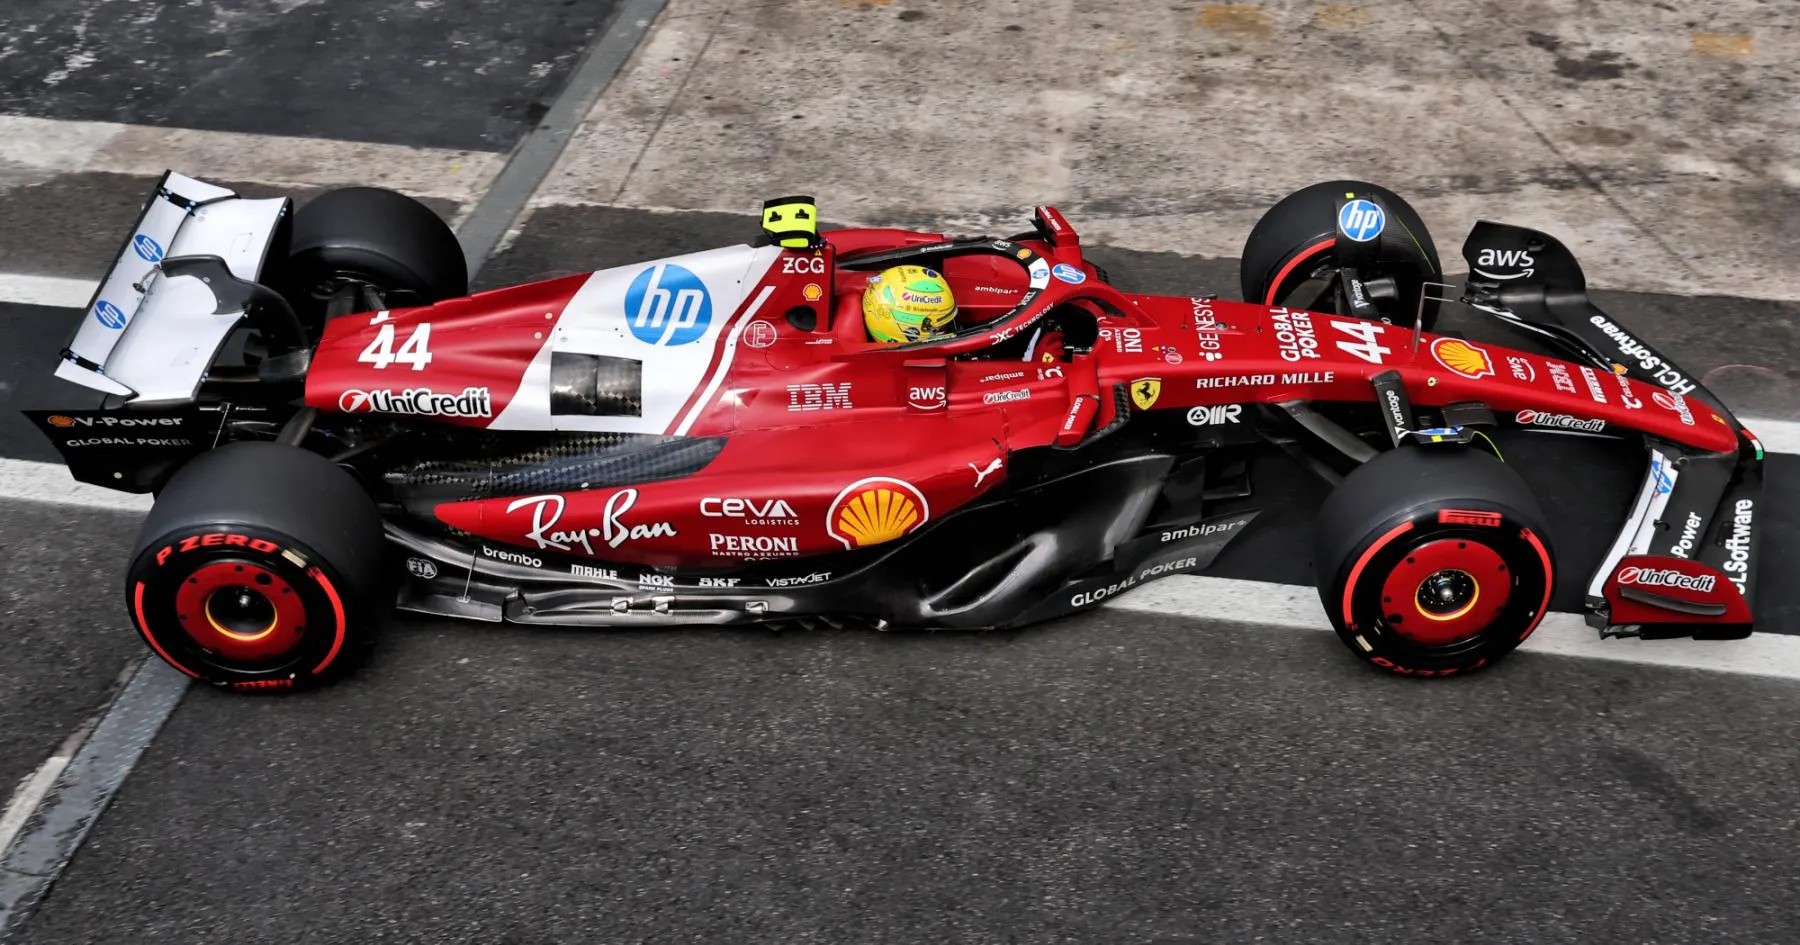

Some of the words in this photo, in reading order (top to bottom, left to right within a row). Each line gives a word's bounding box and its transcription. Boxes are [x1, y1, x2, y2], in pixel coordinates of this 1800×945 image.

[1344, 200, 1379, 241] hp
[134, 234, 163, 262] hp
[1477, 248, 1534, 267] aws
[911, 295, 943, 304] UniCredit
[975, 286, 1013, 294] ambipar
[95, 301, 126, 329] hp
[633, 264, 704, 346] hp
[989, 327, 1014, 346] DXC
[1014, 301, 1054, 333] TECHNOLOGY
[1191, 297, 1220, 350] GENESY
[1269, 307, 1300, 362] GLOBAL
[1291, 312, 1320, 358] POKER
[357, 322, 433, 371] 44
[1330, 320, 1391, 364] 44
[1506, 356, 1527, 381] aws
[1590, 315, 1696, 396] HCLSoftware
[1196, 374, 1276, 389] RICHARD
[1281, 371, 1335, 385] MILLE
[371, 387, 492, 417] UniCredit
[786, 382, 853, 412] IBM
[909, 386, 946, 401] aws
[993, 388, 1031, 403] UniCredit
[76, 415, 183, 427] V-Power
[1533, 411, 1606, 432] UniCredit
[66, 437, 134, 447] GLOBAL
[137, 438, 191, 446] POKER
[709, 533, 799, 552] PERONI
[1160, 522, 1237, 542] ambipar
[1670, 511, 1702, 558] Power
[156, 546, 173, 566] P
[178, 533, 279, 554] ZERO
[482, 545, 543, 568] brembo
[1723, 499, 1753, 595] LSoftware
[571, 564, 618, 581] MAHLE
[639, 573, 674, 587] NGK
[698, 577, 741, 587] SKF
[1070, 578, 1136, 607] GLOBAL
[1140, 557, 1197, 579] POKER
[1637, 568, 1716, 593] UniCredit
